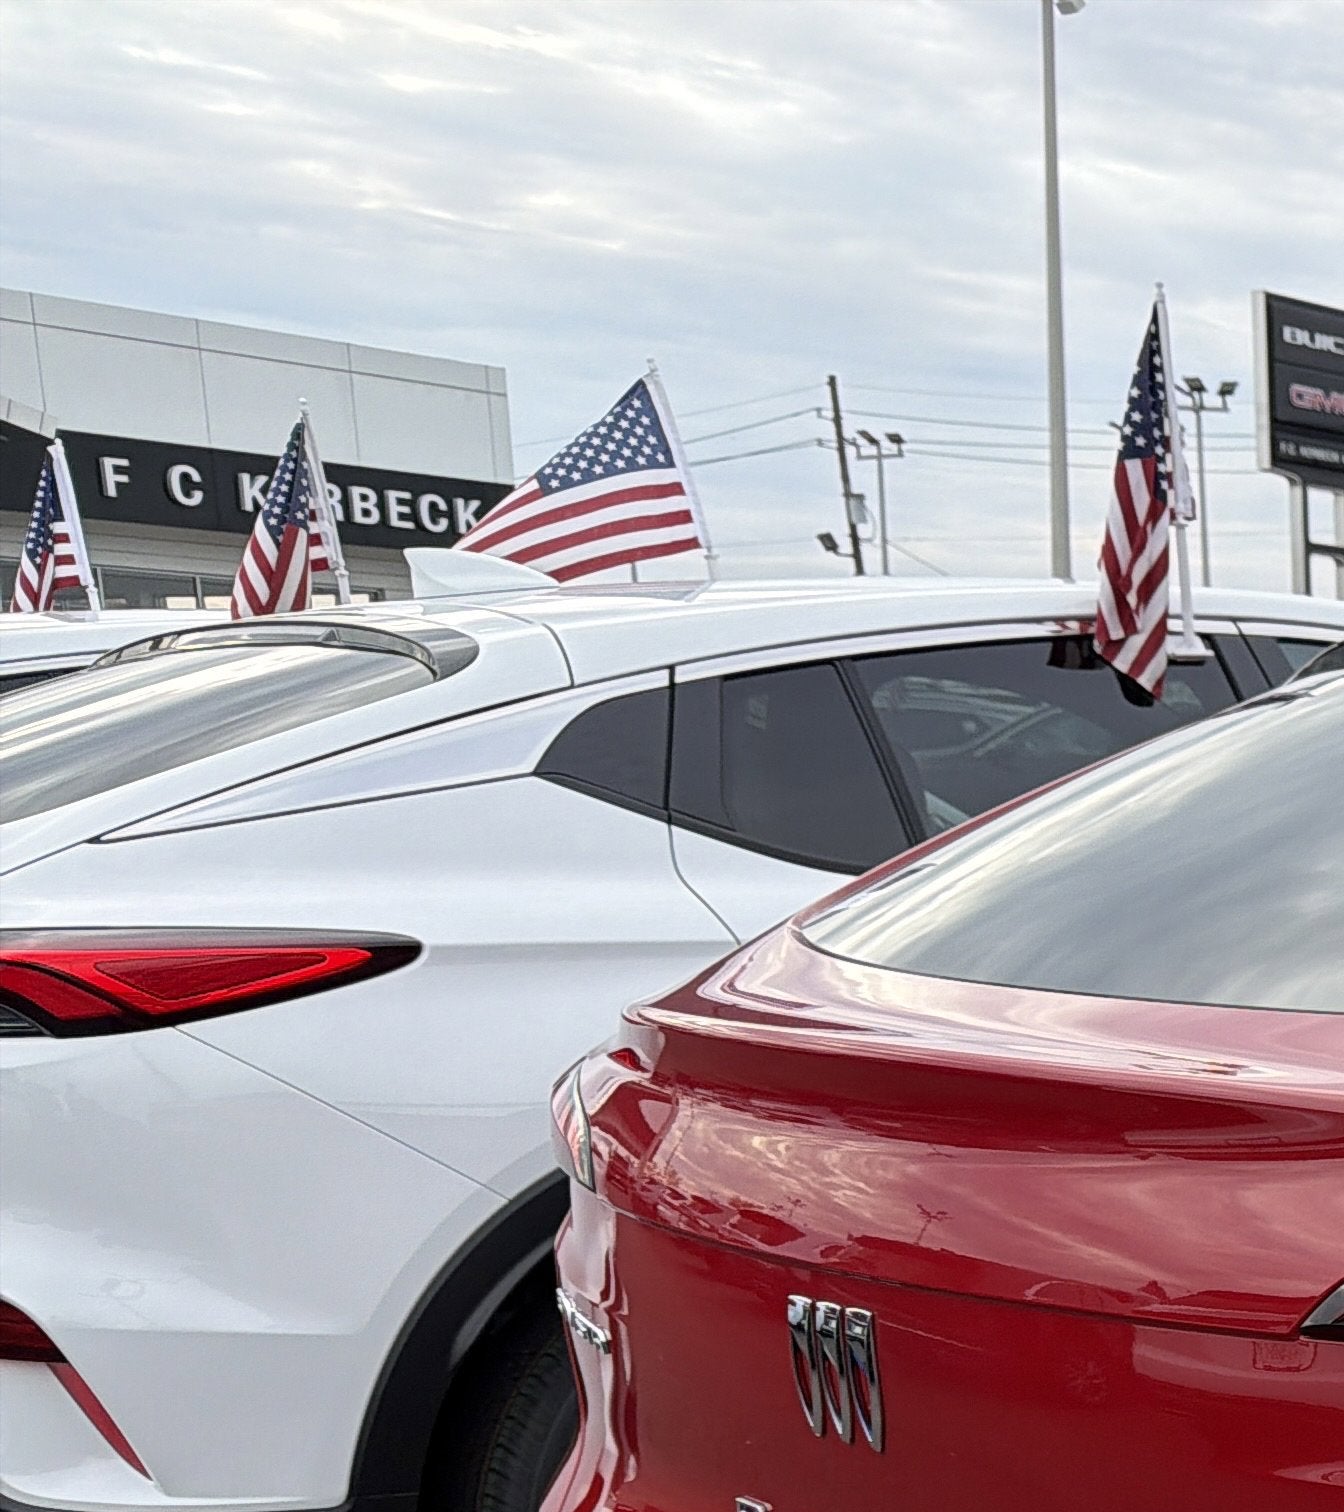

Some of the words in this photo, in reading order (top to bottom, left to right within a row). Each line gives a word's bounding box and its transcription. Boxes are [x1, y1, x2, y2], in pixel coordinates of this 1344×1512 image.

[100, 456, 130, 498] F
[166, 464, 204, 507] C
[237, 472, 482, 535] KRBECK
